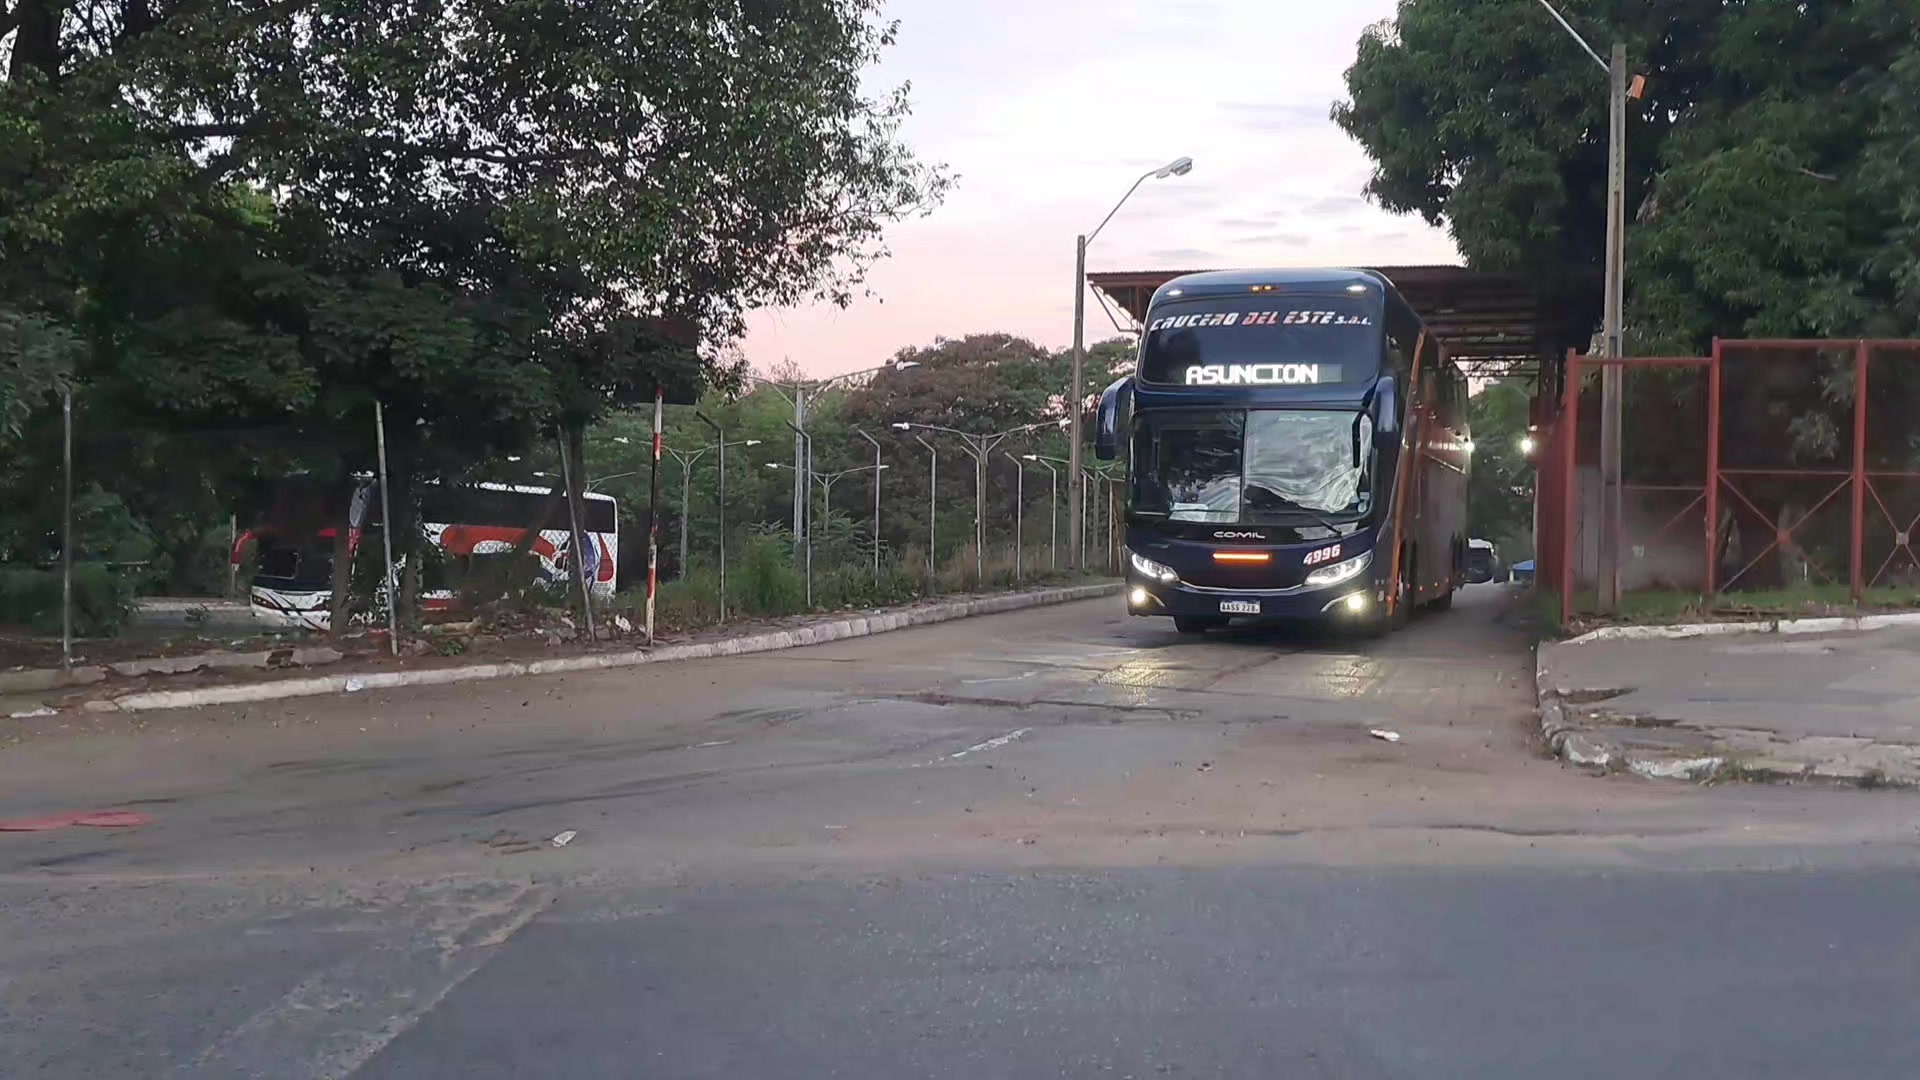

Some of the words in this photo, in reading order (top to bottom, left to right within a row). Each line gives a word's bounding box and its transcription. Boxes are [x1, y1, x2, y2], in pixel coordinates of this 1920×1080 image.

[1150, 312, 1239, 331] CRUCERO
[1242, 311, 1278, 326] DEL
[1283, 311, 1335, 325] ESTE
[1185, 363, 1318, 385] ASUNCION
[1213, 531, 1266, 539] COMIL
[1303, 544, 1341, 565] 4996
